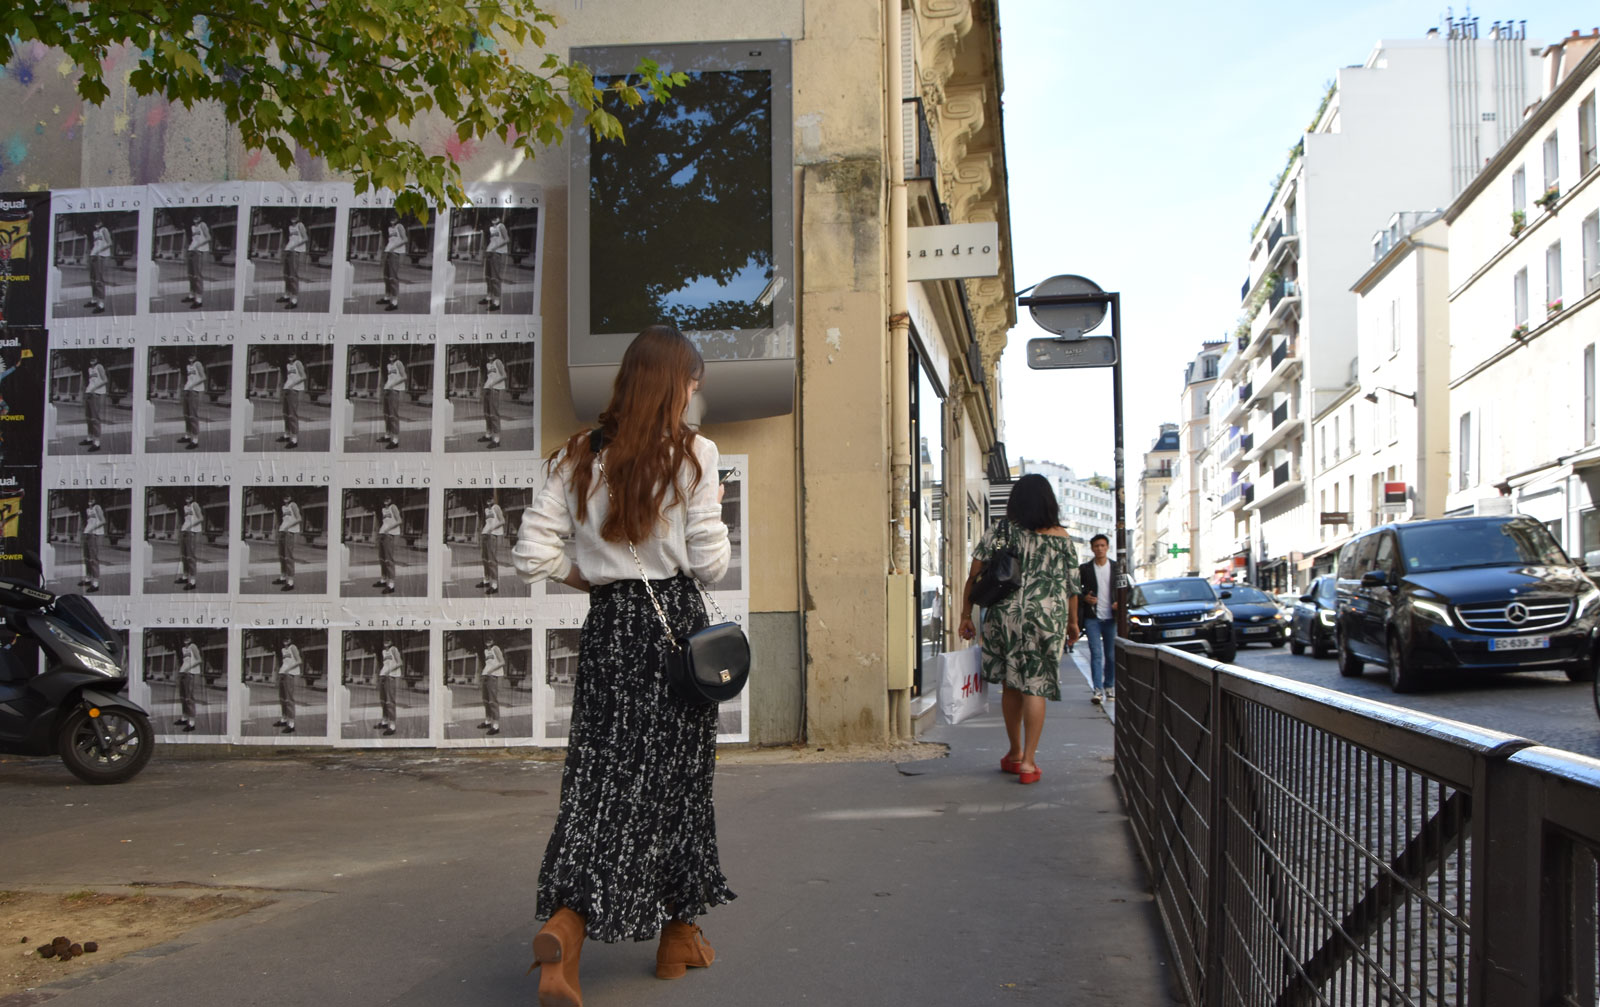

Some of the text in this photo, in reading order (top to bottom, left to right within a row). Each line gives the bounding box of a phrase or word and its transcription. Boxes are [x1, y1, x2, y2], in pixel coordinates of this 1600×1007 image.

[166, 194, 240, 205] sandro
[263, 193, 338, 204] sandro
[362, 195, 437, 205] sano
[466, 194, 539, 204] andro
[67, 199, 141, 210] sandro
[63, 335, 135, 346] sandro
[161, 332, 234, 343] sandro
[260, 331, 335, 341] sandro
[361, 331, 436, 341] sandro
[459, 329, 535, 341] sandro
[60, 475, 133, 486] sandro
[157, 473, 231, 483] sandro
[255, 473, 330, 483] sandro
[355, 474, 430, 485] sandro
[457, 474, 533, 485] sandro
[156, 614, 229, 624] sandro
[255, 615, 329, 626] sandro
[355, 616, 431, 627] sandro
[456, 615, 533, 627] sandro
[961, 672, 982, 698] H&M
